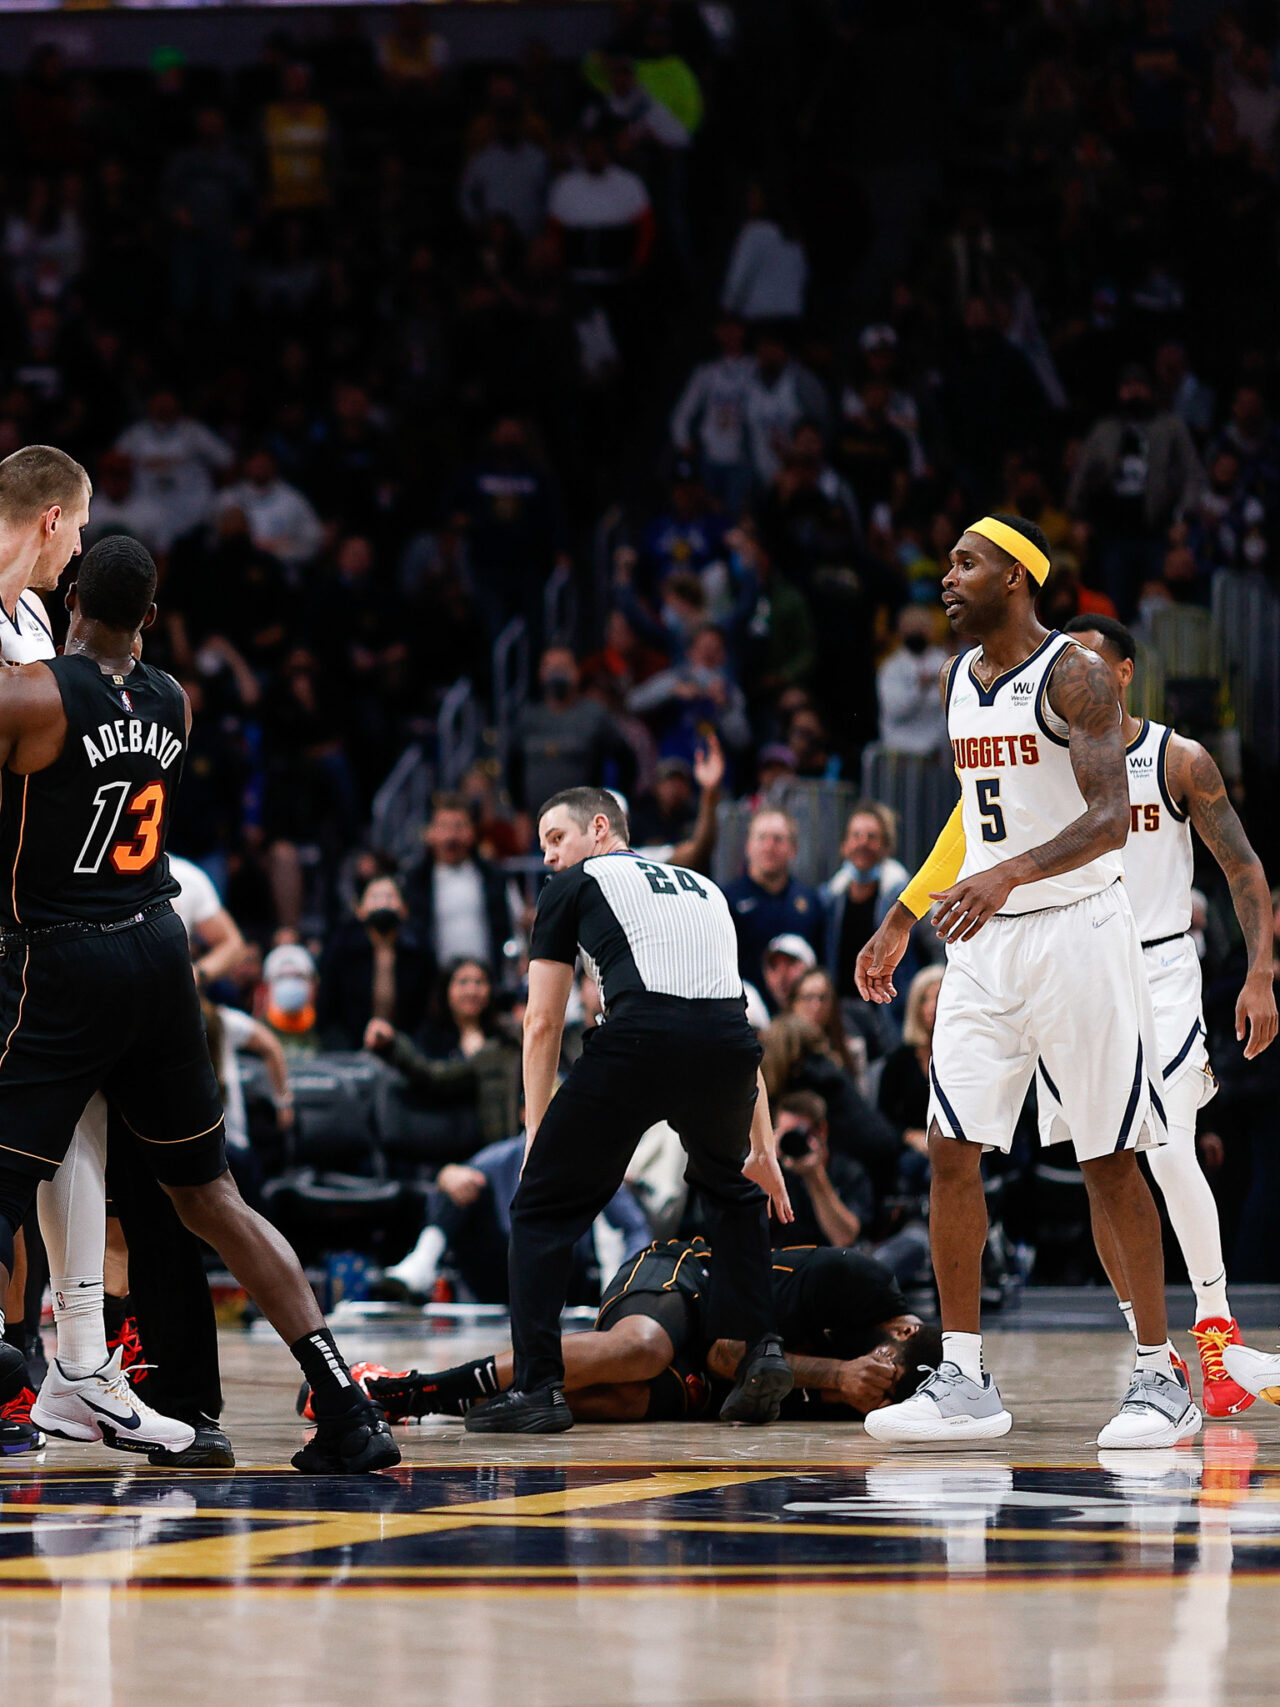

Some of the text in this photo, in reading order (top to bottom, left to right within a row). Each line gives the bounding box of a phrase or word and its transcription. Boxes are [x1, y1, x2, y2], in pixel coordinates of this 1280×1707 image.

[1013, 681, 1035, 694] WU
[82, 719, 183, 770] ADEBAYO
[952, 734, 1040, 770] UGGETS
[1129, 756, 1153, 768] WU
[73, 779, 167, 876] 13
[975, 777, 1008, 844] 5
[635, 861, 708, 899] 24
